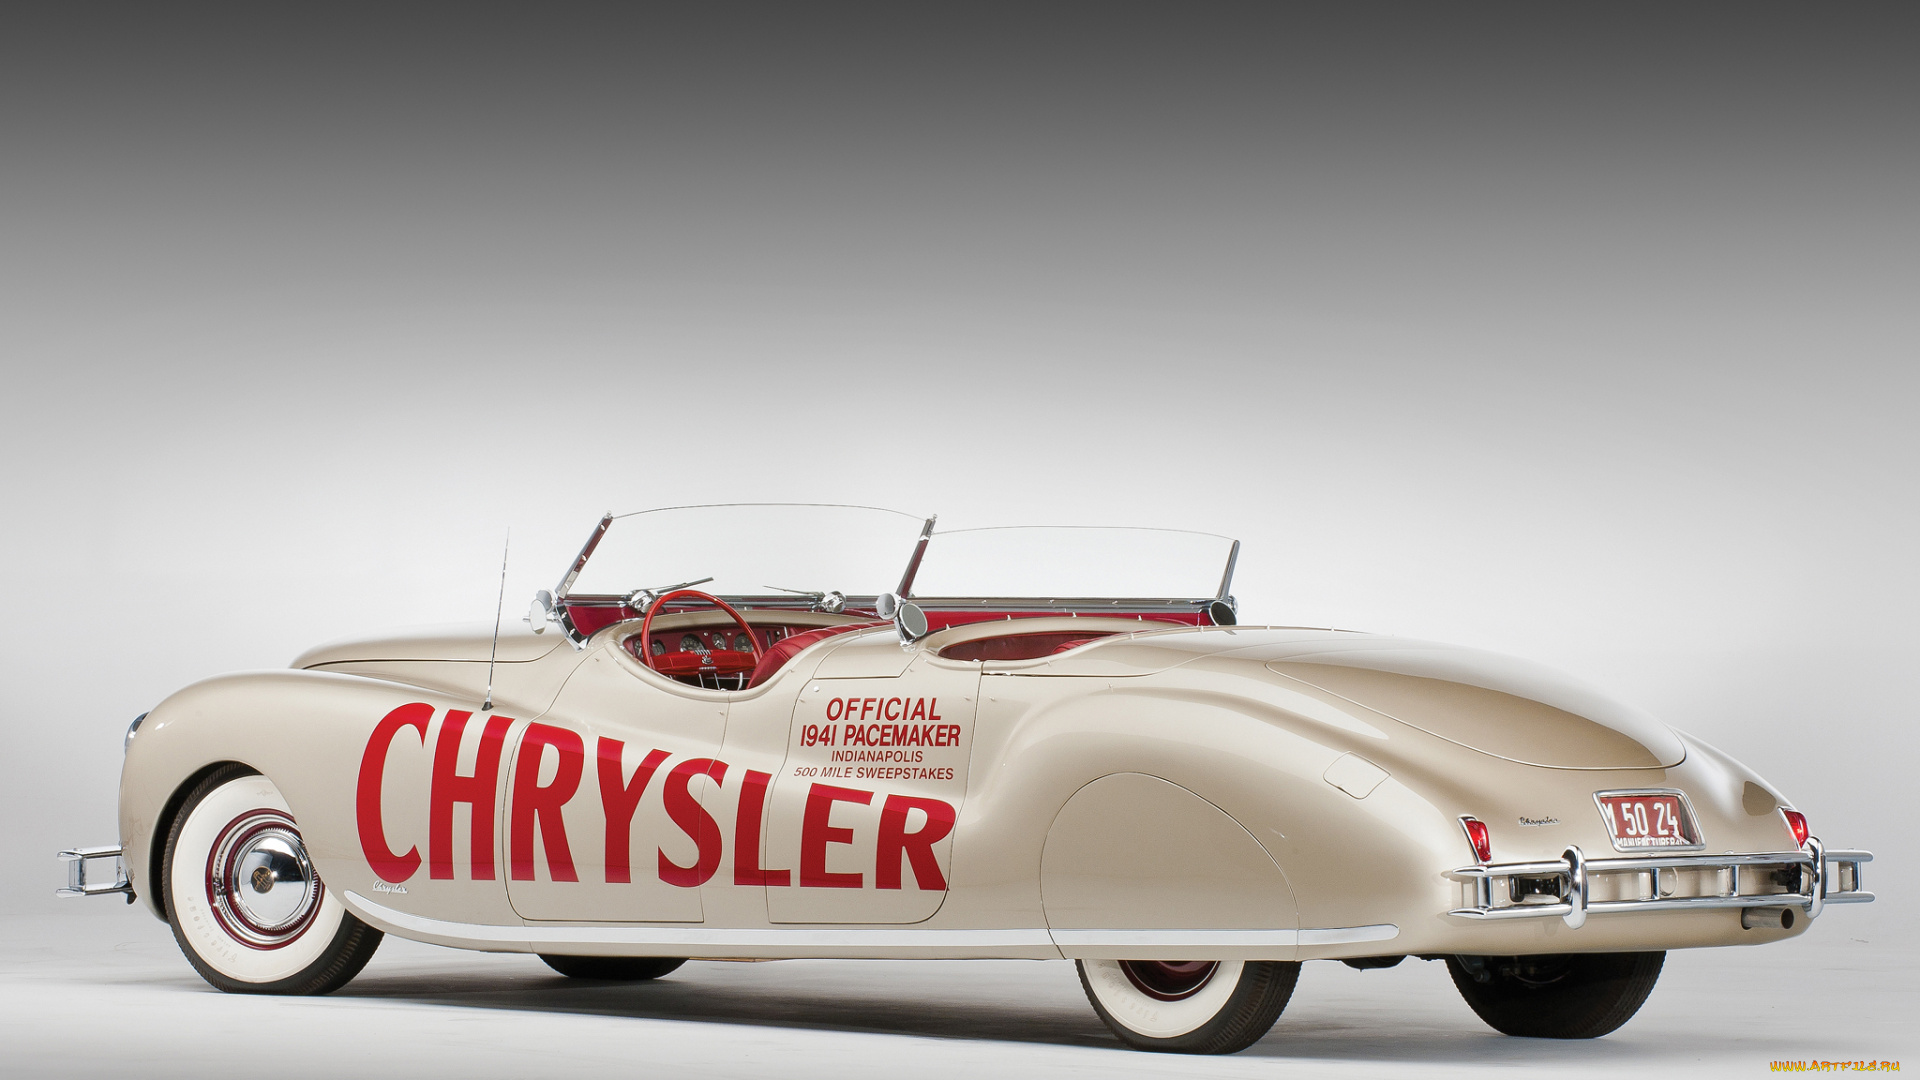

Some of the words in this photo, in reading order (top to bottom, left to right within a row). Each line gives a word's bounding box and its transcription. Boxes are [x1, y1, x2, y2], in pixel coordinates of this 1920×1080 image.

[826, 697, 942, 721] OFFICIAL
[800, 724, 837, 747] 1941
[843, 724, 961, 747] PACEMAKER
[831, 750, 923, 763] INDIANAPOLIS
[793, 767, 818, 777] 500
[820, 767, 853, 778] MILE
[856, 767, 954, 780] SWEEPSTAKES
[356, 702, 957, 891] CHRYSLER
[1621, 803, 1649, 835] 50
[1653, 803, 1680, 835] 24
[372, 880, 408, 894] Chrysler
